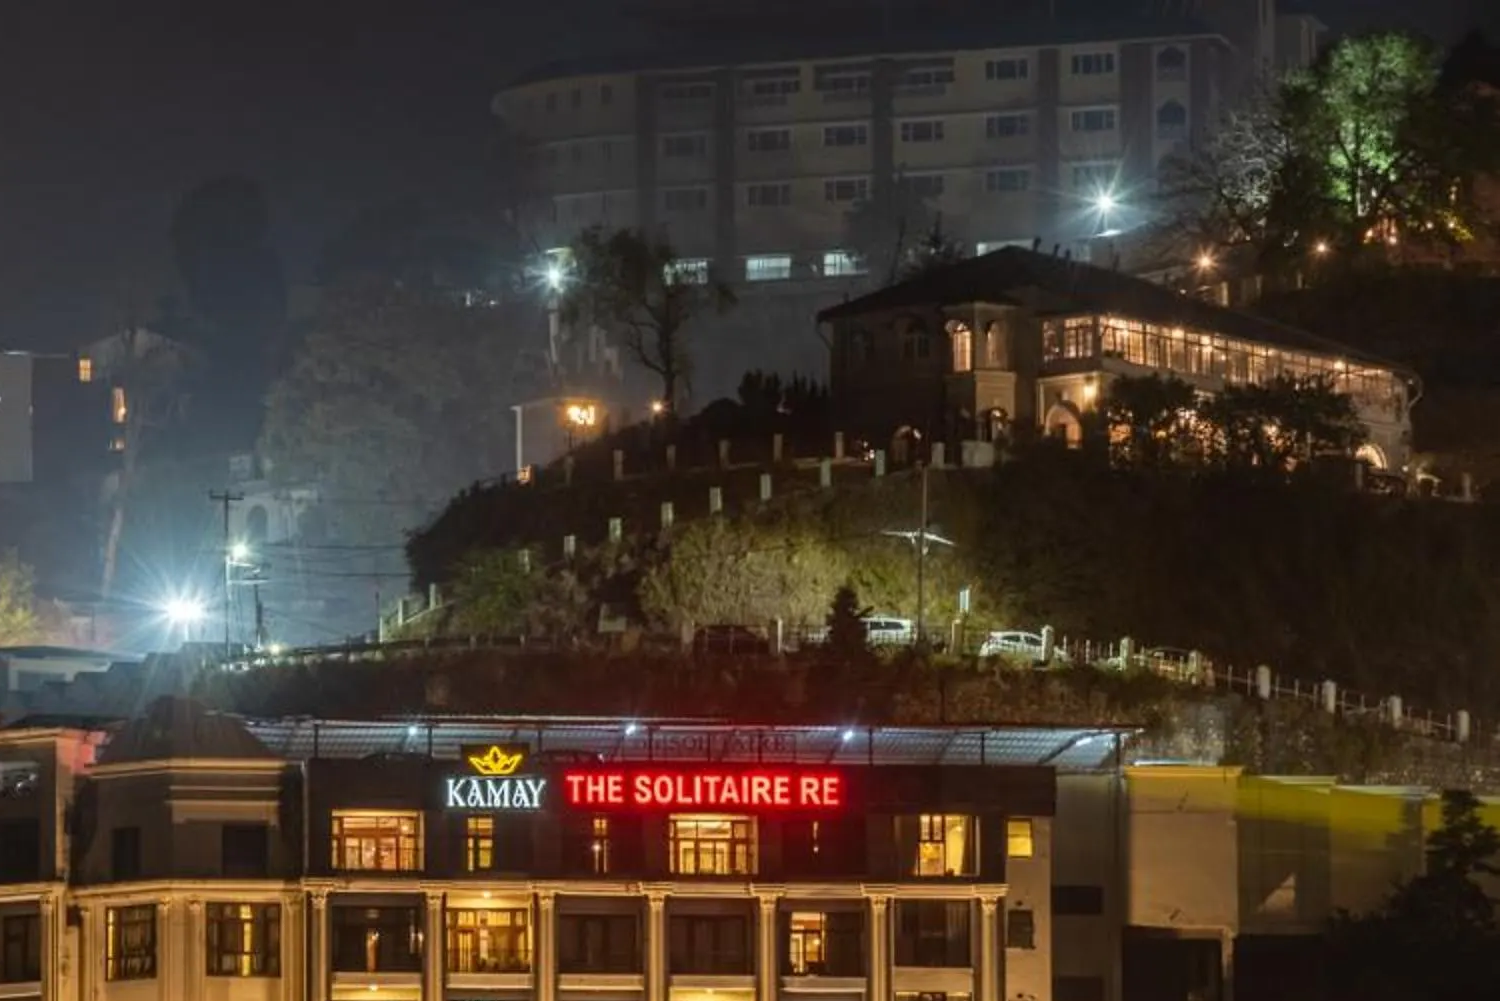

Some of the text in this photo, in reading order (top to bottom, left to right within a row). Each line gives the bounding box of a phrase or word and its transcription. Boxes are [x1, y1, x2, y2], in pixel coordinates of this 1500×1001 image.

[446, 777, 546, 808] KAMAY
[566, 774, 840, 806] THE SOLITAIRE RE
